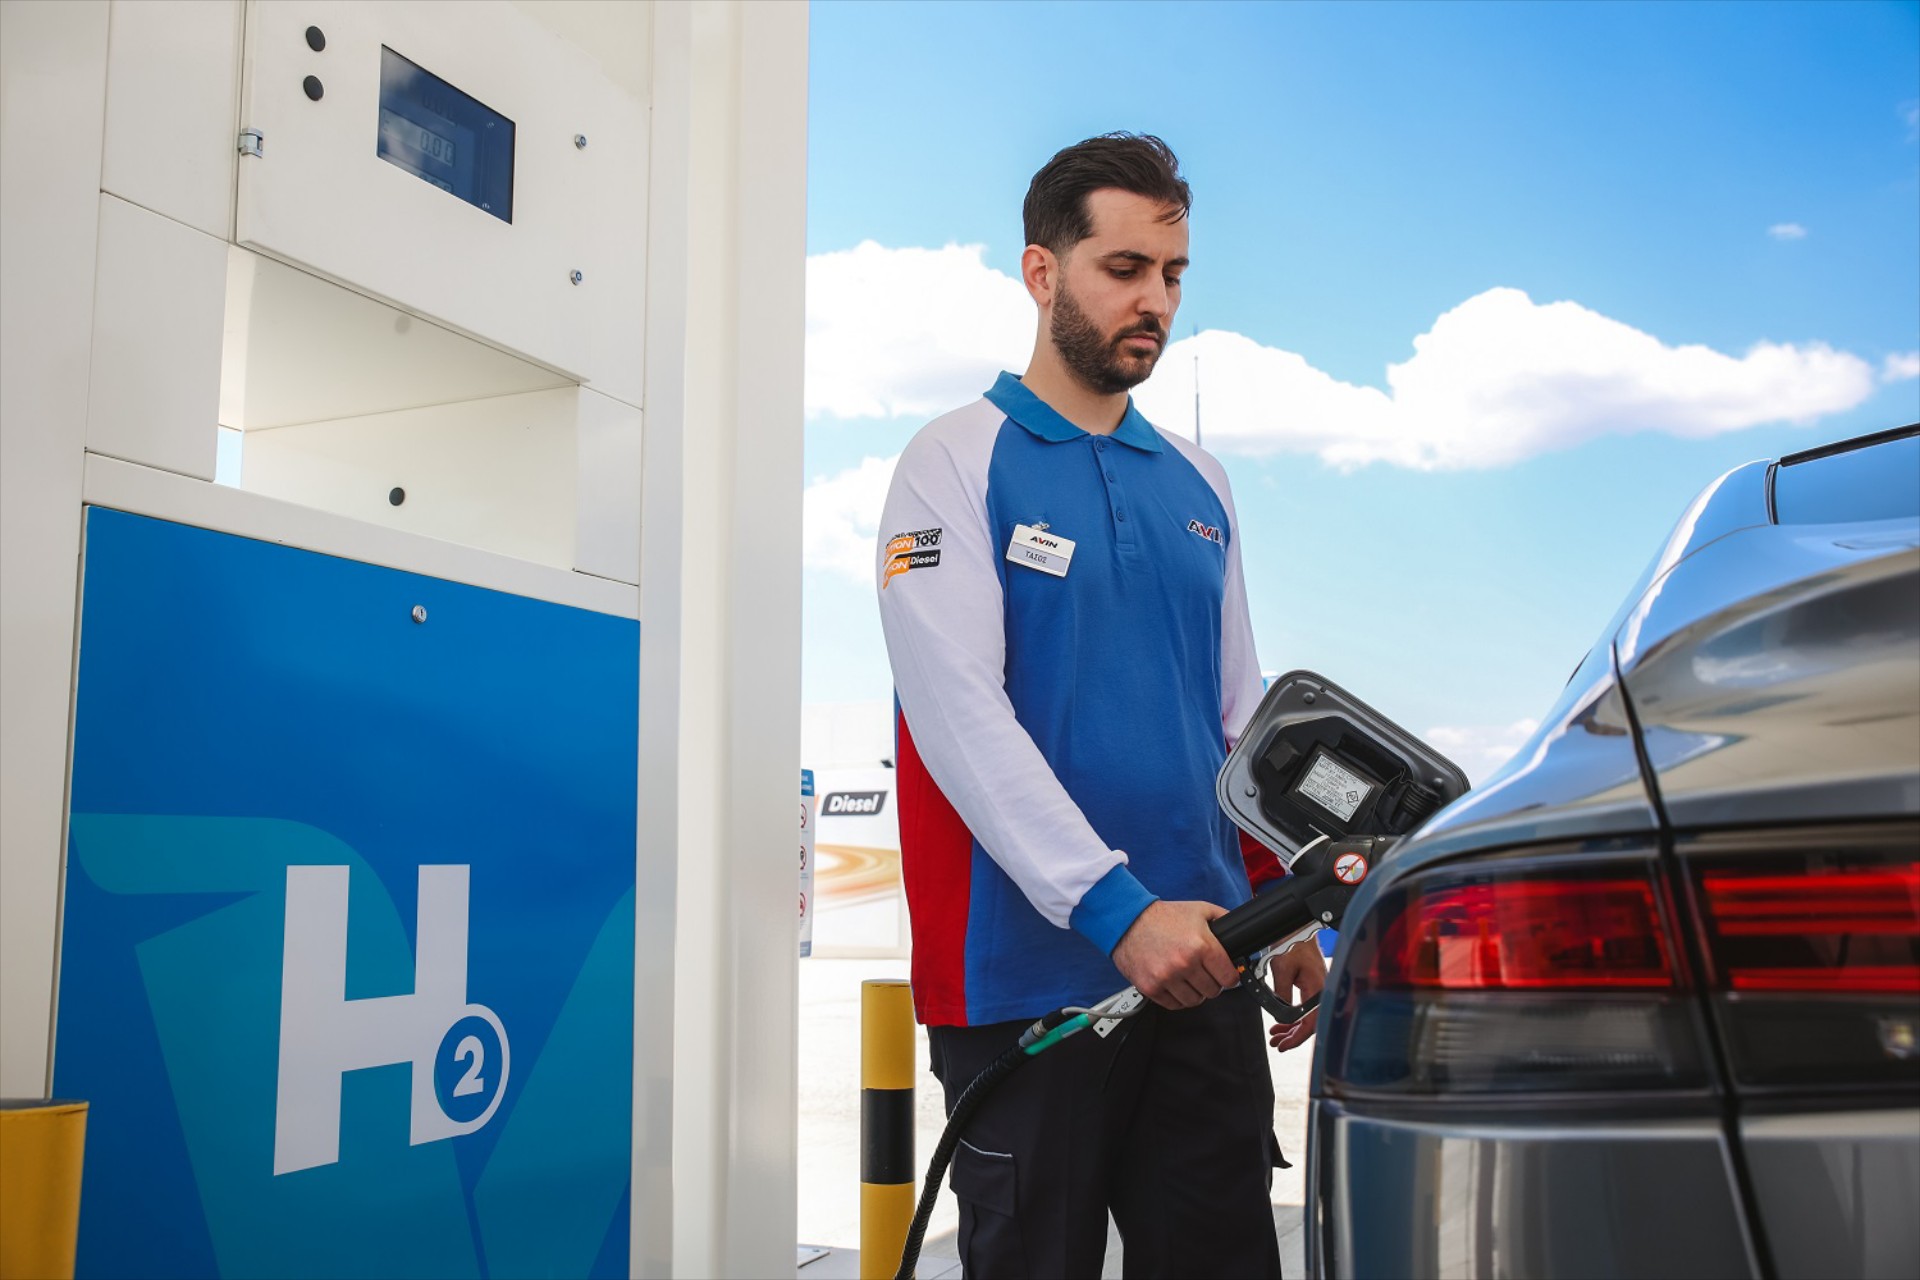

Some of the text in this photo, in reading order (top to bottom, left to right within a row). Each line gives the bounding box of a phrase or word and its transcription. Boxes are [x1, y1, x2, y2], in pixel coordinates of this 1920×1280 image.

[1187, 519, 1223, 545] AVI
[914, 533, 939, 548] 100
[1030, 536, 1058, 548] AVIN
[911, 553, 938, 565] Diesel
[828, 794, 879, 813] Diesel
